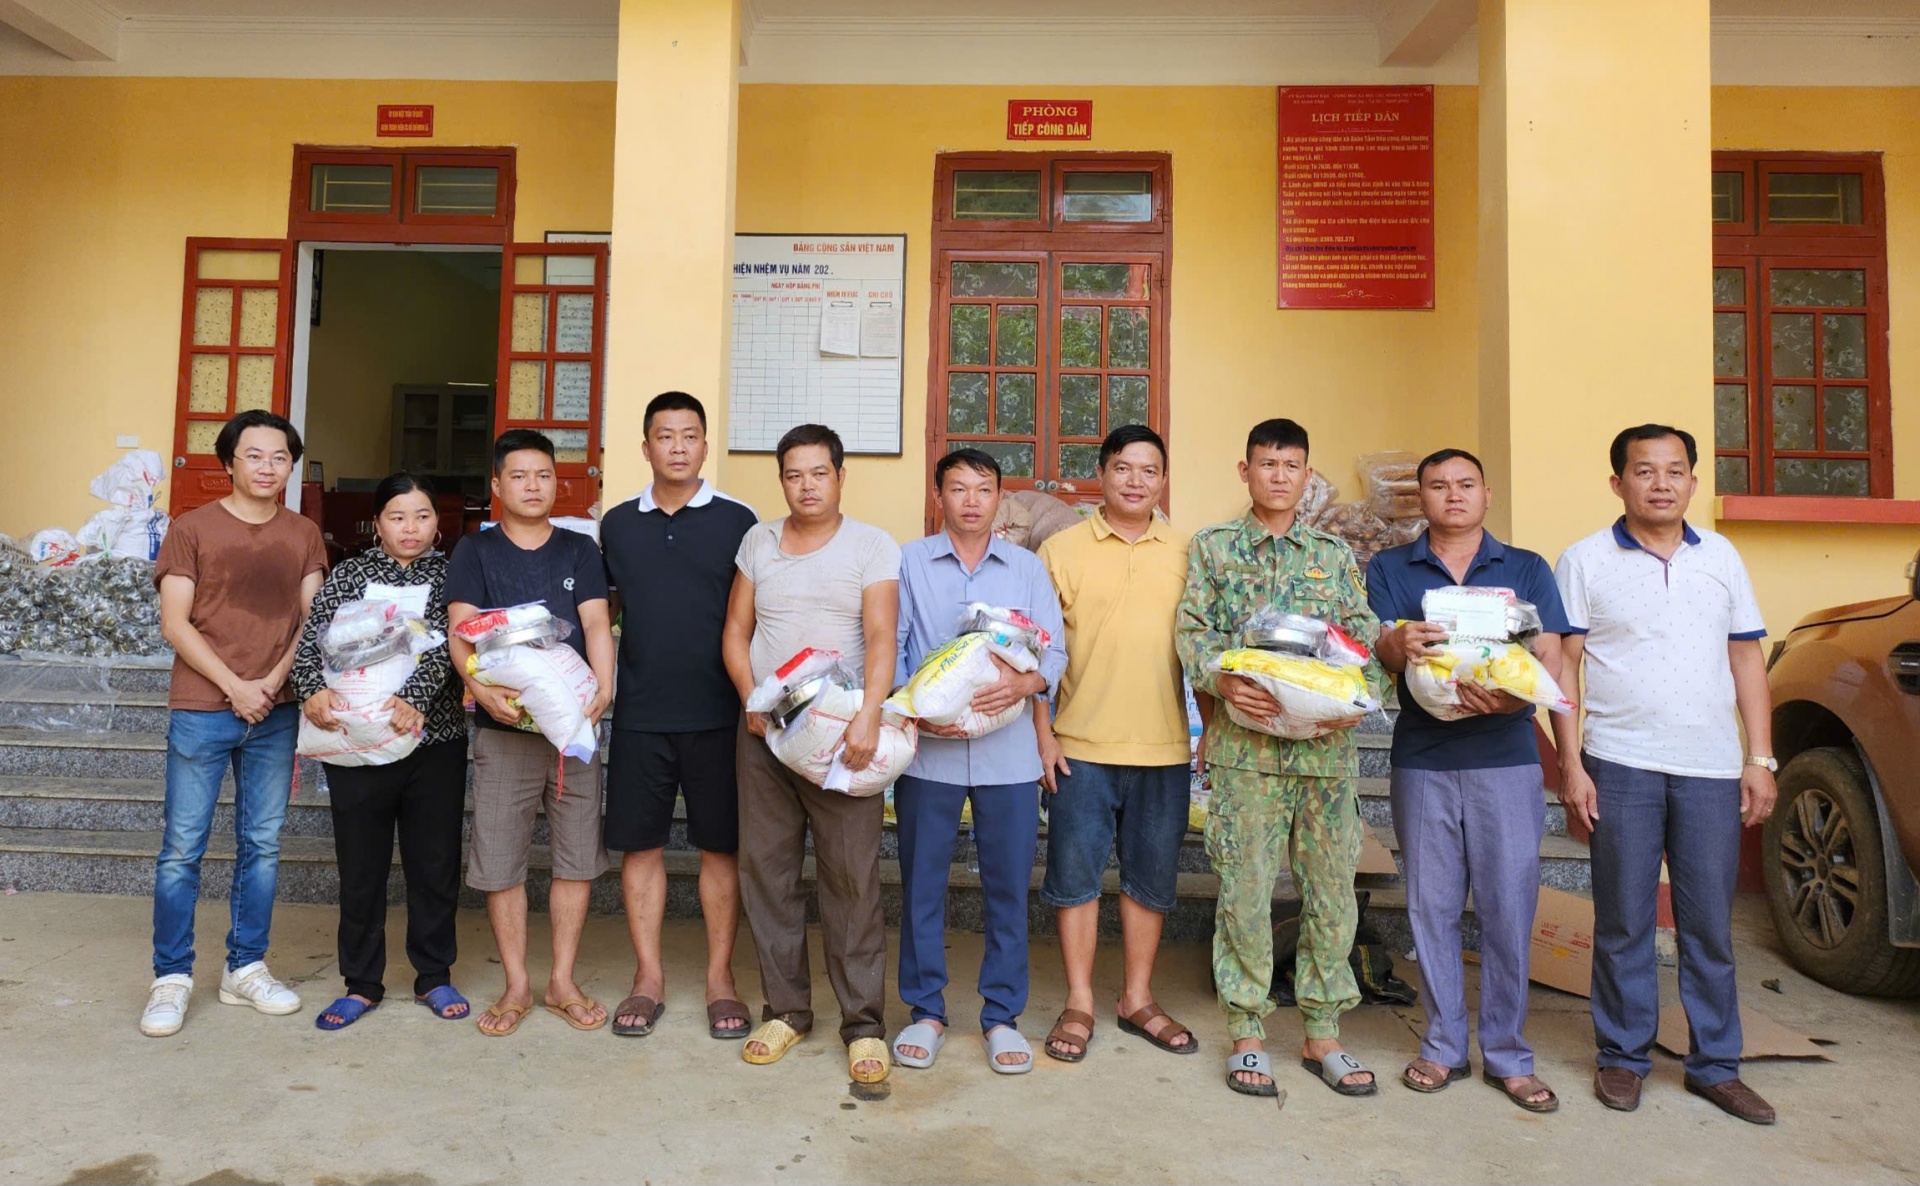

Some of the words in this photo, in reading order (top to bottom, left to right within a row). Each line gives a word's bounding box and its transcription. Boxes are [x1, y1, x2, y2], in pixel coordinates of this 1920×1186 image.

[1022, 104, 1078, 116] PHÒNG
[1312, 114, 1340, 124] LỊCH
[1344, 109, 1371, 122] TIẾP
[1374, 110, 1400, 122] DÂN
[1014, 120, 1034, 136] TIẾP
[1038, 122, 1063, 136] CÔNG
[1067, 122, 1086, 136] DÂN
[817, 243, 838, 254] CỘNG
[840, 242, 855, 252] SẢN
[858, 243, 874, 254] VIỆT
[876, 244, 894, 252] NAM
[733, 262, 752, 276] HIỆN
[780, 264, 789, 276] VỤ
[792, 262, 810, 274] NĂM
[1240, 1051, 1259, 1069] G
